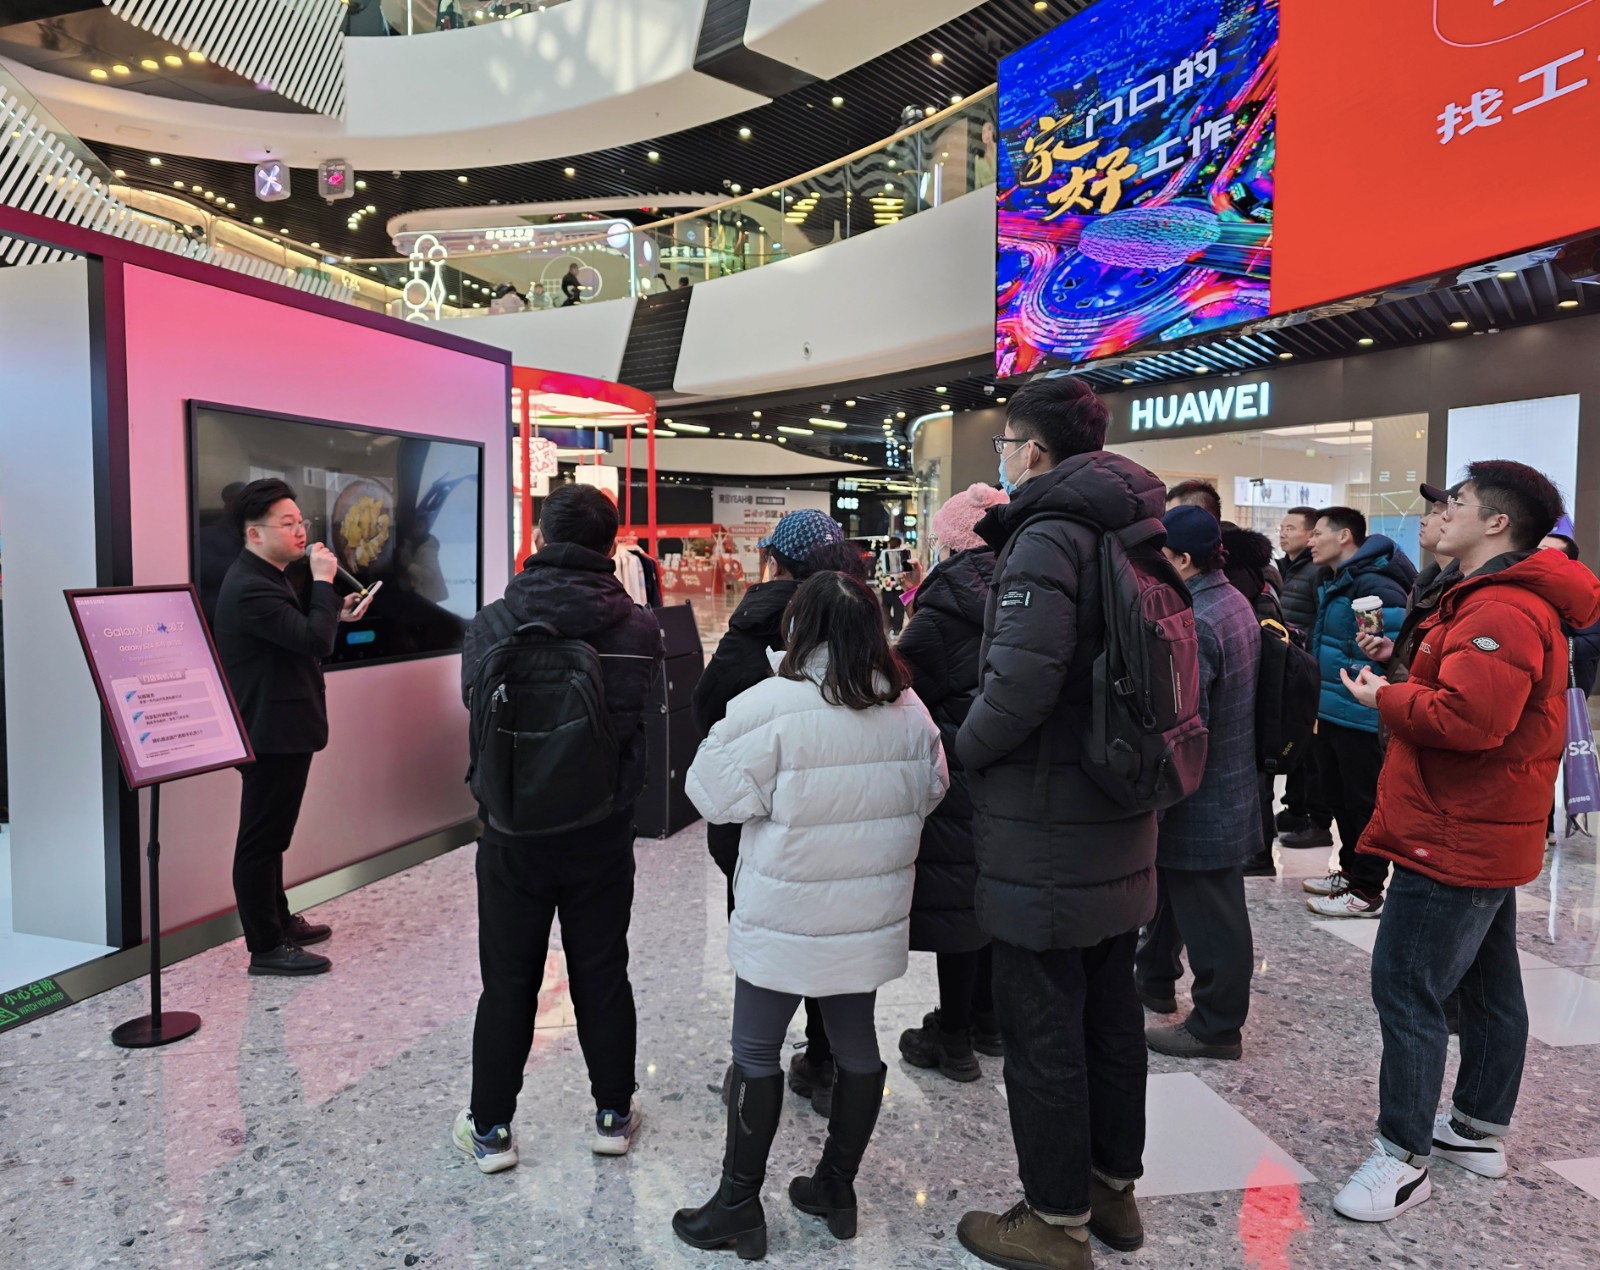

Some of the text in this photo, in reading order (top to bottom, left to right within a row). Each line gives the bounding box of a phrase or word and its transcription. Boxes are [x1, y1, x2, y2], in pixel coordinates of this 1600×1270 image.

[1436, 48, 1600, 145] 找工
[1131, 381, 1270, 431] HUAWEI
[103, 625, 144, 638] Galaxy
[145, 624, 156, 634] AI
[119, 644, 143, 652] Galaxy
[1568, 795, 1591, 804] SUNG
[4, 979, 56, 1005] 小心台阶
[17, 992, 64, 1015] WATCH YOUR STEP
